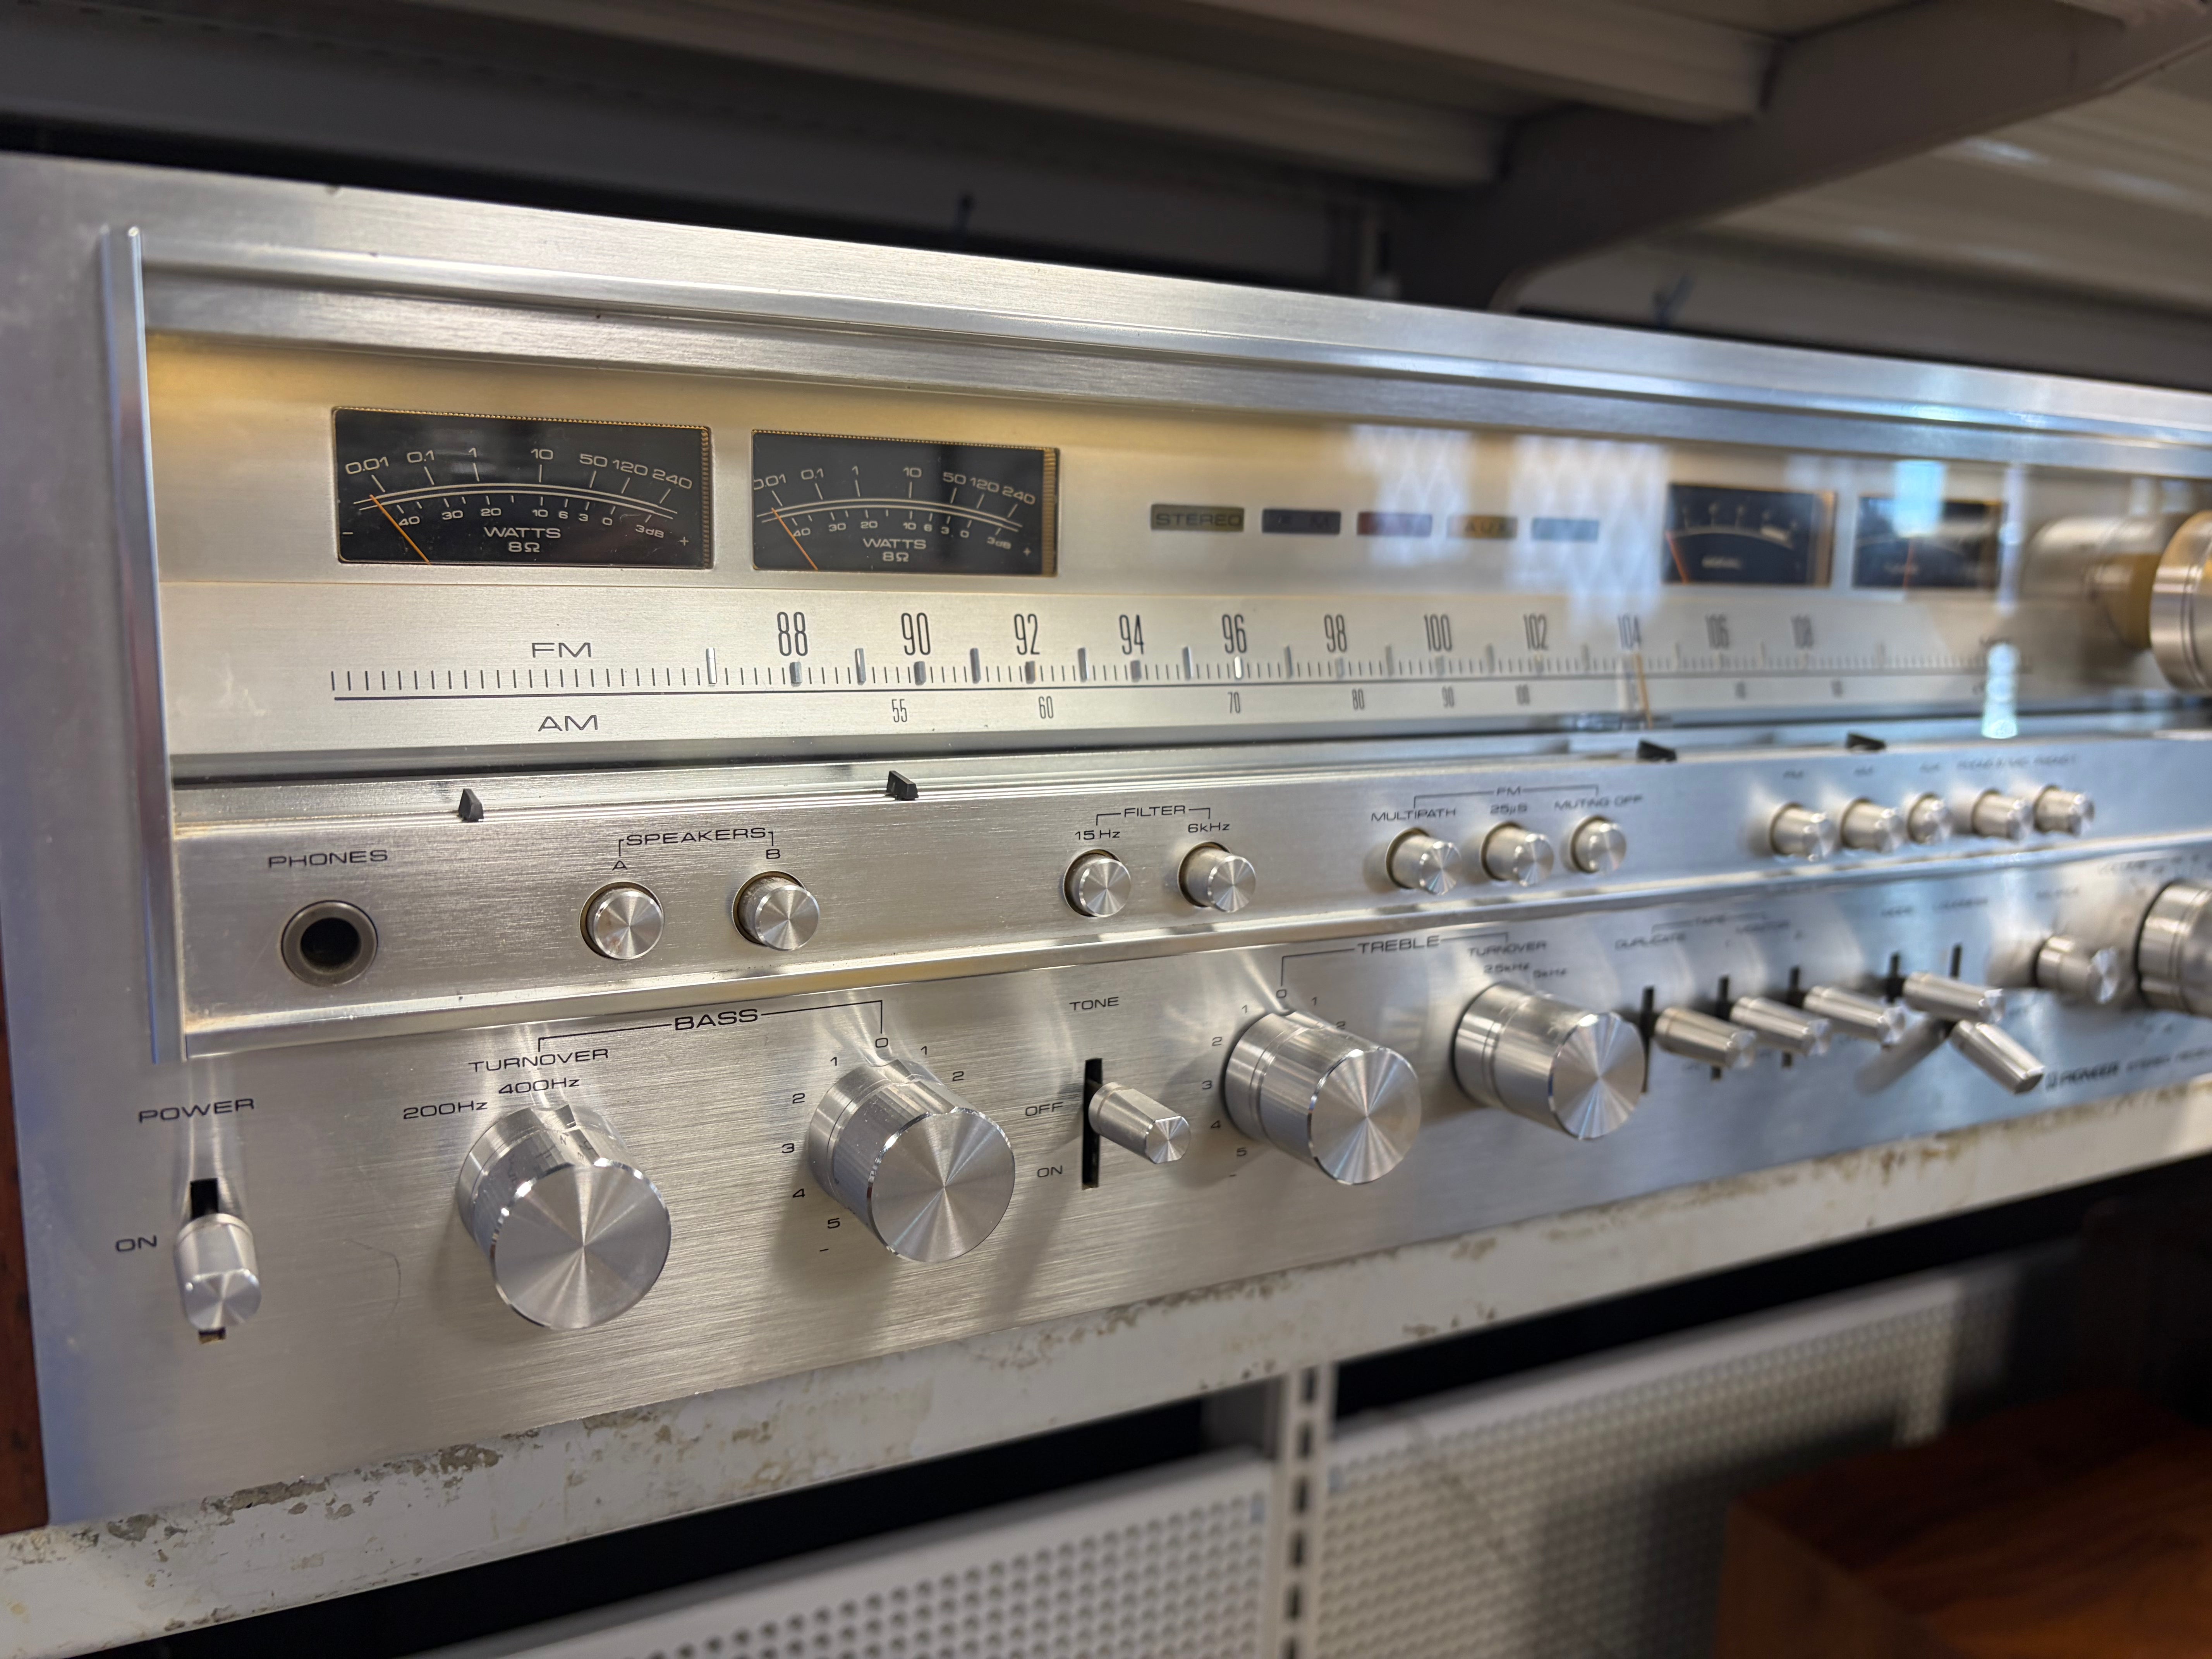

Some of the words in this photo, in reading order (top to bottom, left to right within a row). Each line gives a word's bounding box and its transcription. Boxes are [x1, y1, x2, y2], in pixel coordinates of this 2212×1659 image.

[345, 457, 389, 474] 0.01
[407, 450, 434, 463] 0.1
[468, 447, 477, 458] 1
[531, 448, 553, 460] 10
[579, 453, 608, 467] 50
[612, 460, 648, 476] 120
[652, 469, 692, 489] 240
[801, 468, 824, 480] 0.1
[852, 466, 859, 475] 1
[903, 467, 922, 477] 10
[943, 472, 967, 485] 50
[970, 477, 1000, 493] 120
[1002, 486, 1036, 505] 240
[399, 515, 420, 526] 40
[441, 510, 463, 520] 30
[481, 508, 501, 517] 20
[532, 509, 548, 517] 10
[558, 511, 568, 519] 6
[579, 514, 588, 522] 3
[602, 517, 613, 526] 0
[1156, 512, 1240, 528] STEREO
[484, 527, 561, 538] WATTS
[793, 527, 811, 537] 40
[829, 523, 846, 532] 30
[941, 526, 950, 534] 3
[960, 530, 969, 538] 0
[508, 541, 540, 553] 8Ω
[863, 538, 926, 549] WATTS
[883, 551, 909, 562] 8Ω
[532, 642, 591, 658] FM
[777, 611, 808, 656] 88
[901, 612, 931, 656] 90
[1014, 613, 1040, 655] 92
[1119, 615, 1144, 655] 94
[1222, 614, 1247, 654] 96
[1324, 614, 1347, 653] 98
[1424, 614, 1453, 651] 100
[1524, 615, 1547, 650] 102
[538, 715, 598, 732] AM
[891, 699, 907, 723] 55
[1038, 696, 1054, 719] 60
[1228, 692, 1241, 714] 70
[1352, 689, 1365, 709] 80
[1496, 786, 1521, 795] FM
[1554, 797, 1611, 810] MUTING
[1614, 795, 1642, 805] OFF
[1124, 805, 1185, 818] FILTER
[1371, 808, 1456, 822] MULTIPATH
[1188, 822, 1230, 833] 6kHz
[626, 828, 766, 847] SPEAKERS
[268, 850, 388, 869] PHONES
[766, 849, 781, 859] B
[612, 860, 628, 871] A
[1358, 935, 1440, 954] TREBLE
[1467, 941, 1547, 957] TURNOVER
[1276, 989, 1287, 999] 0
[1069, 996, 1119, 1011] TONE
[1311, 997, 1317, 1006] 1
[1242, 1005, 1247, 1014] 1
[675, 1009, 758, 1031] BASS
[875, 1037, 888, 1048] 0
[1212, 1036, 1222, 1047] 2
[921, 1046, 927, 1055] 1
[468, 1049, 609, 1073] TURNOVER
[830, 1056, 837, 1066] 1
[952, 1071, 964, 1082] 2
[498, 1077, 580, 1094] 400Hz
[1202, 1080, 1212, 1090] 3
[792, 1093, 805, 1104] 2
[138, 1098, 254, 1124] POWER
[403, 1101, 487, 1120] 200Hz
[1025, 1102, 1063, 1116] OFF
[1211, 1120, 1221, 1129] 4
[781, 1143, 795, 1154] 3
[1237, 1147, 1247, 1157] 5
[1037, 1165, 1063, 1178] ON
[792, 1188, 805, 1198] 4
[827, 1218, 840, 1229] 5
[115, 1235, 157, 1252] ON
